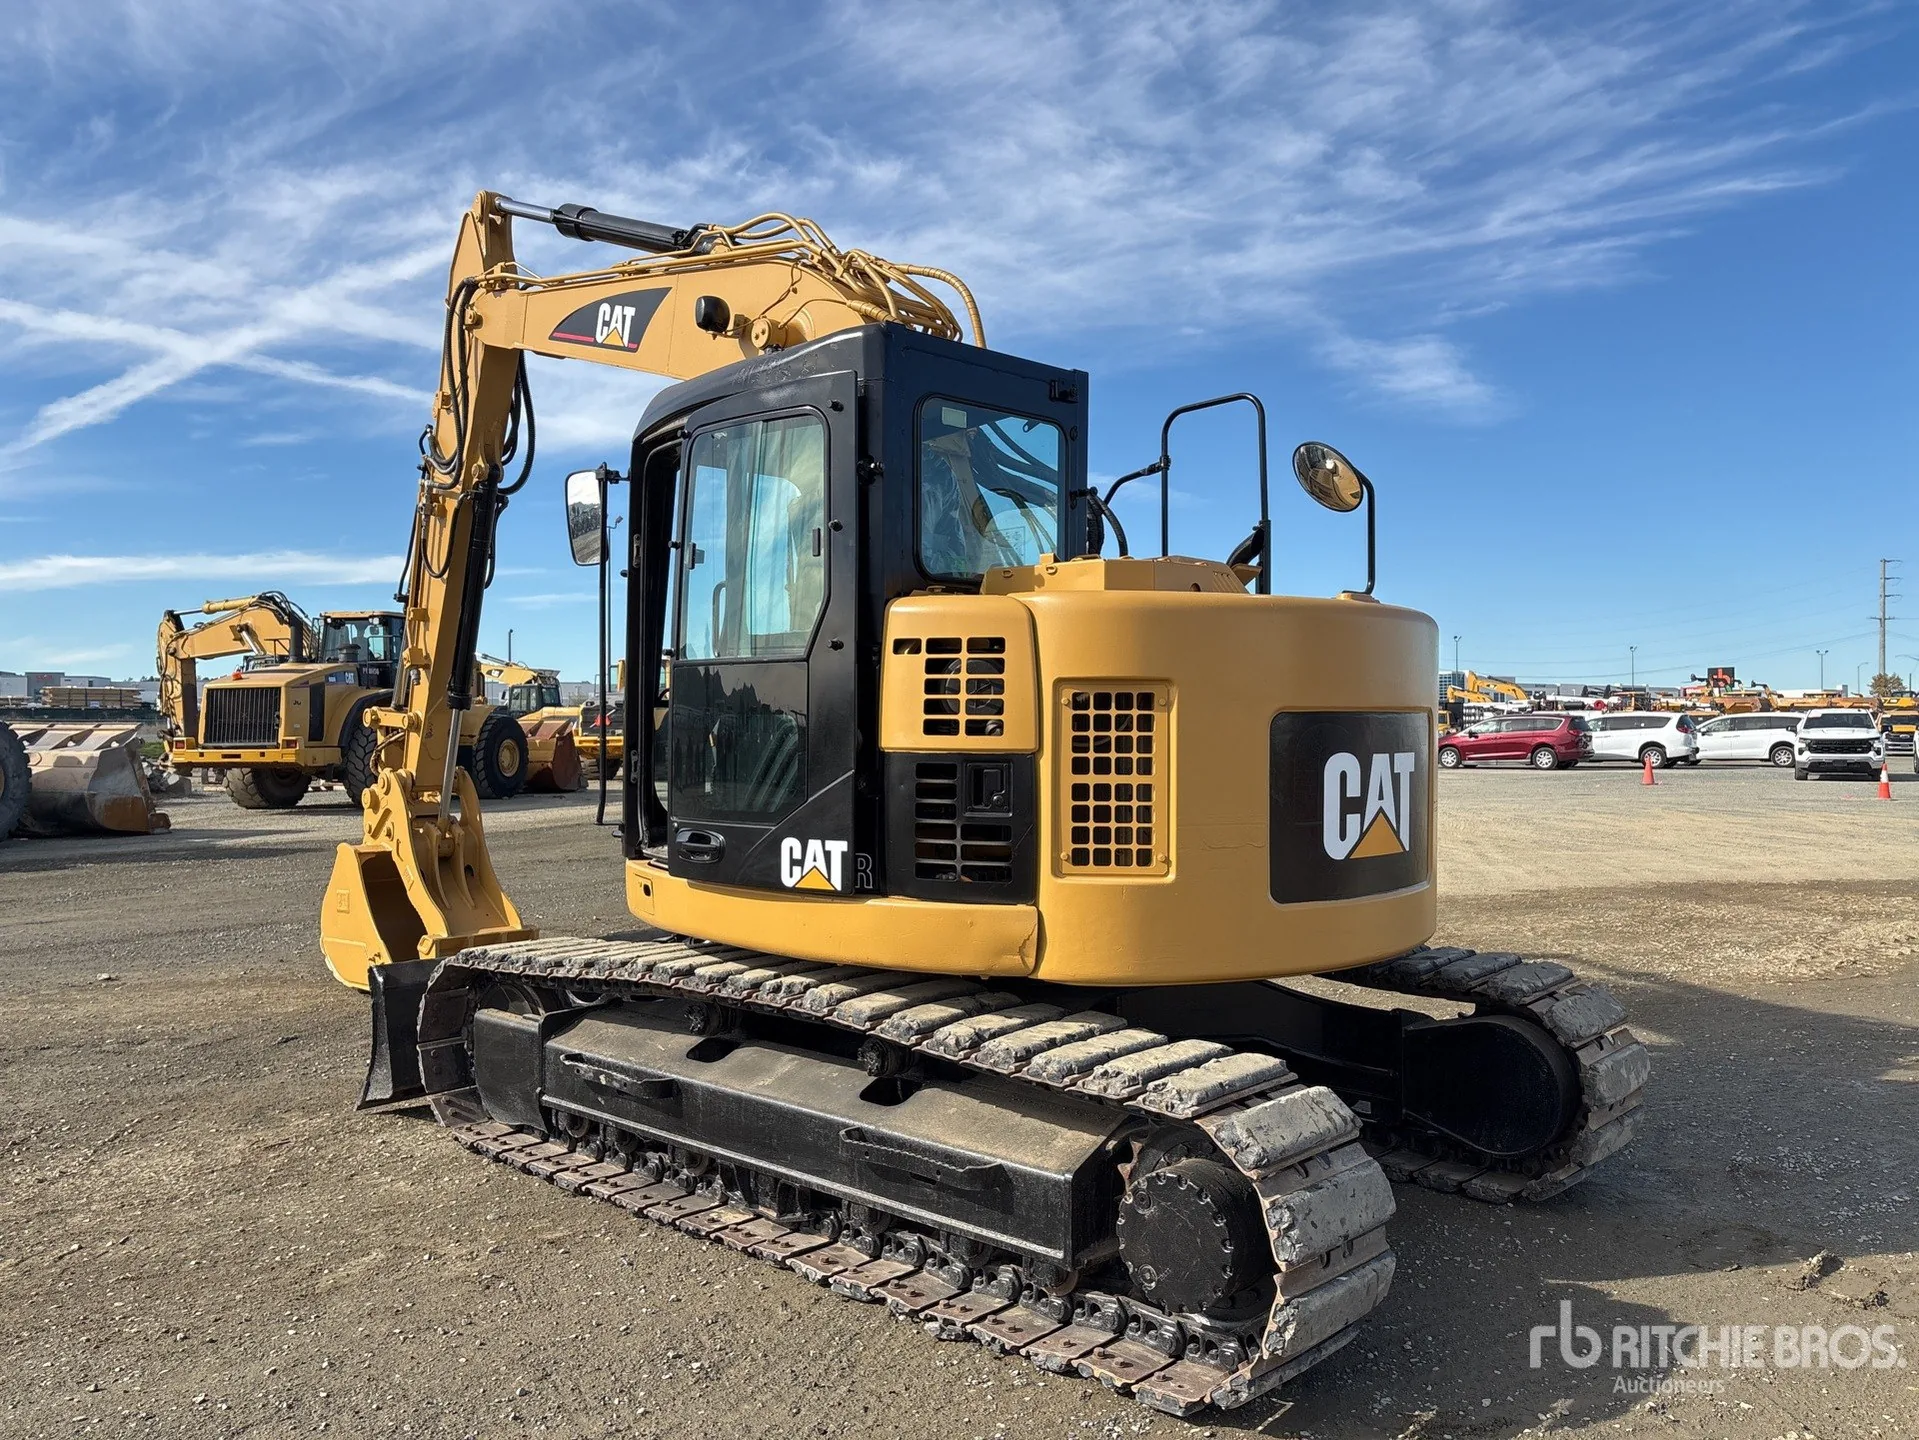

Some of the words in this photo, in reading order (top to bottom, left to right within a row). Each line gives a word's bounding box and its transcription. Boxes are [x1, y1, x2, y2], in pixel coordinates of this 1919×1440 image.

[595, 302, 636, 347] CAT
[1323, 752, 1415, 860] CAT
[781, 836, 848, 891] CAT
